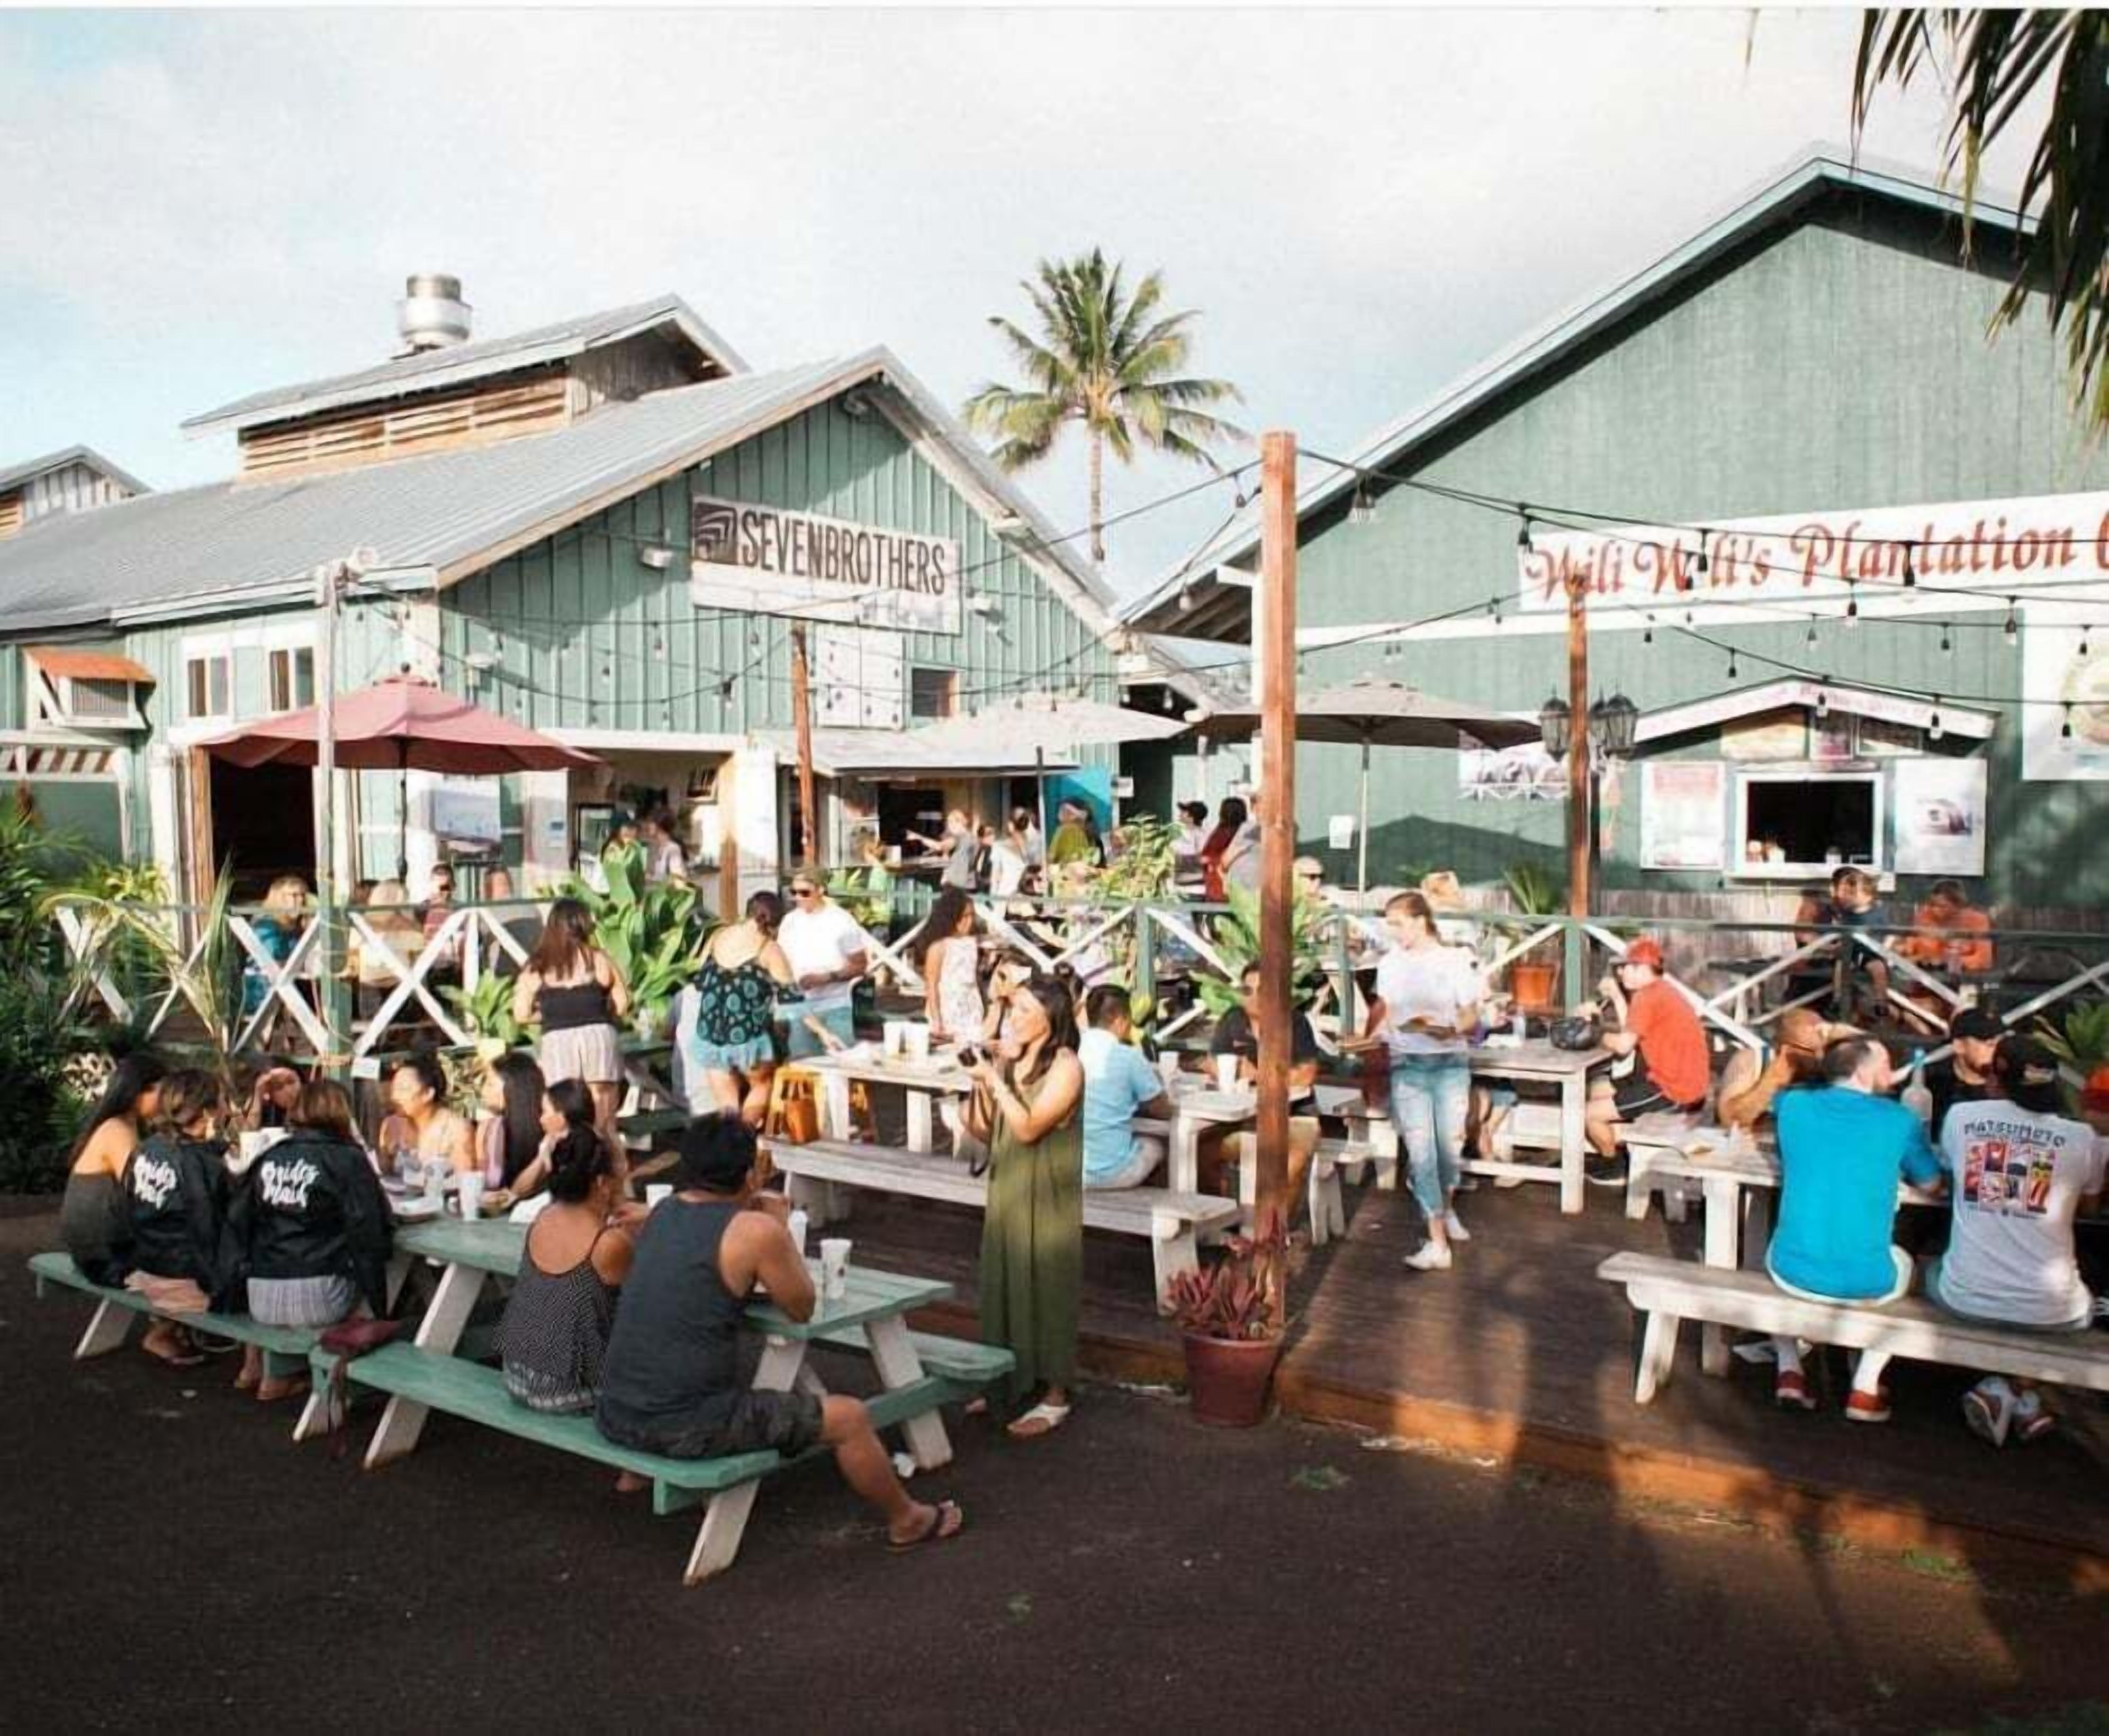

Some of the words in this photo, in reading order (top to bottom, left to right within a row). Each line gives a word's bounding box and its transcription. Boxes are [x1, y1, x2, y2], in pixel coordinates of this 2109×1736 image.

[741, 509, 945, 595] SEVENBROTHERS
[1634, 532, 1771, 594] Wli's
[1790, 516, 2078, 586] Plantation
